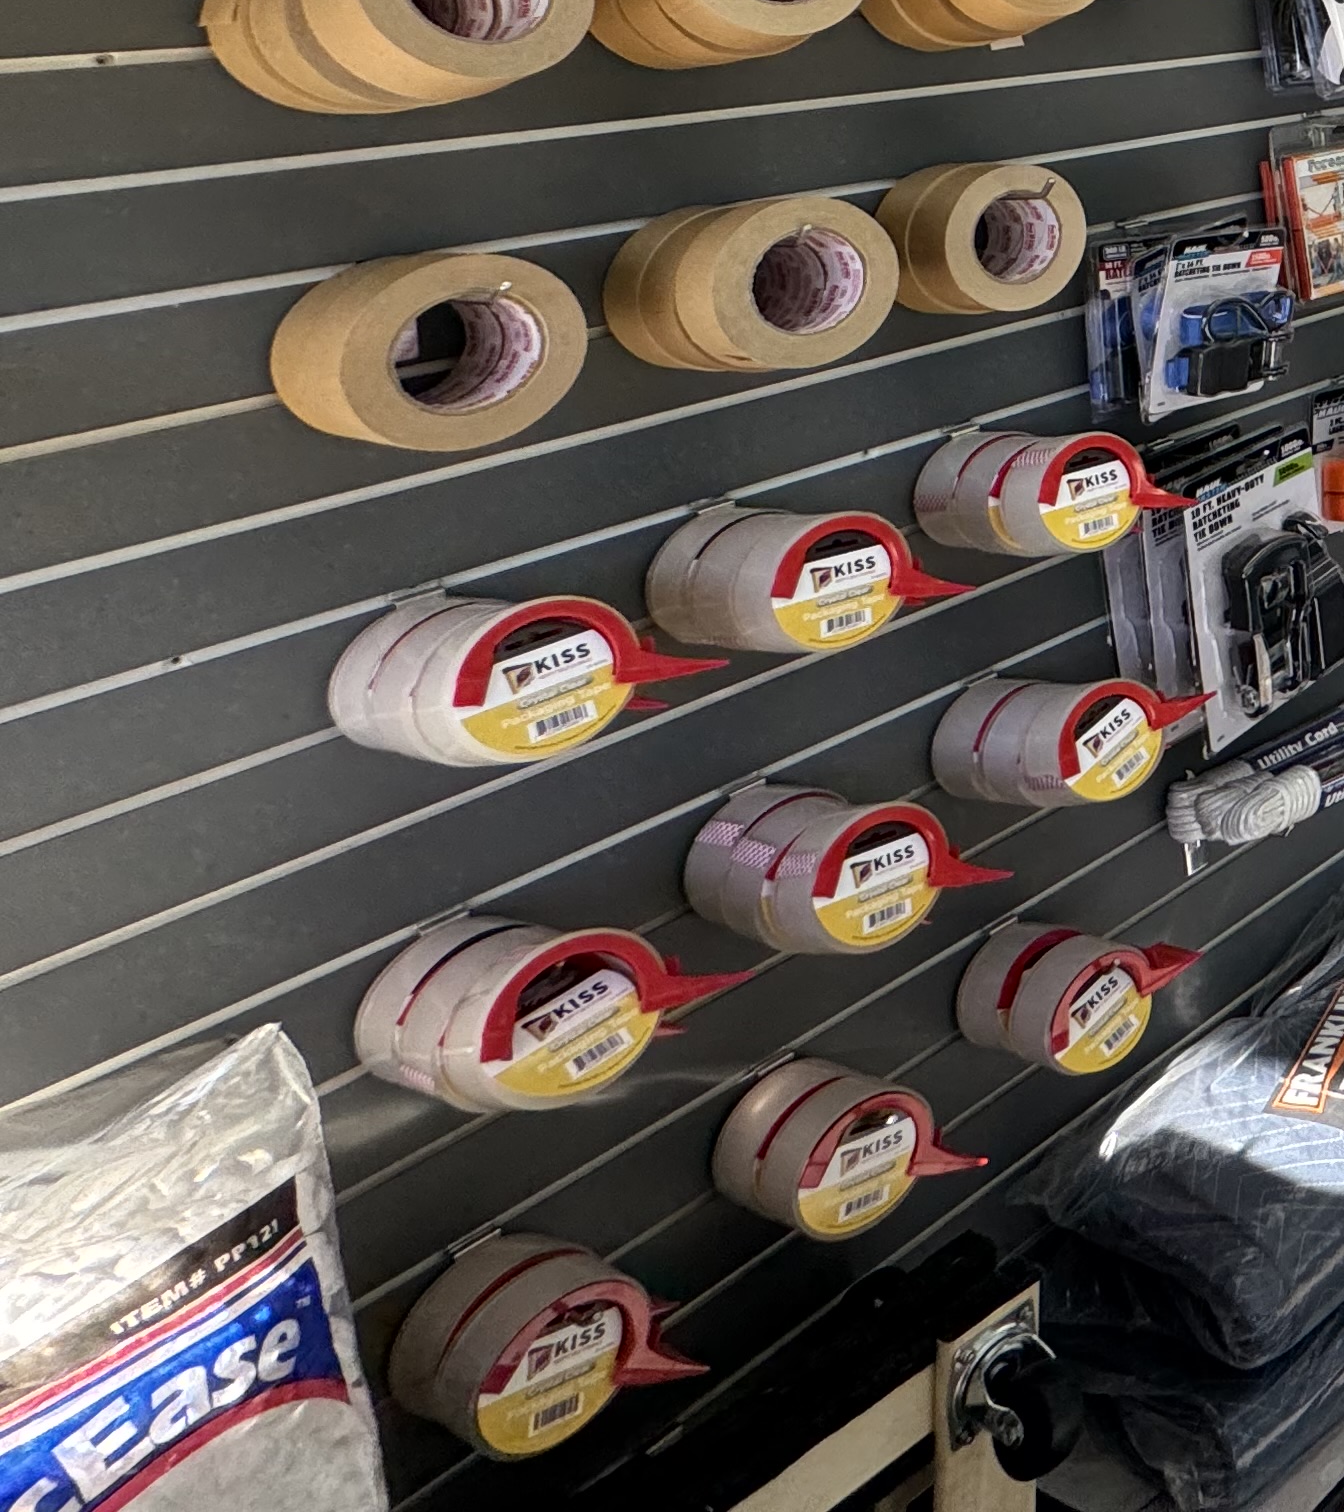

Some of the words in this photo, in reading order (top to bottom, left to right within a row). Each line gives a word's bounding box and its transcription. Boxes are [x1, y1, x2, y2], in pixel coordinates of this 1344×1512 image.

[1085, 469, 1118, 488] KISS
[1203, 500, 1214, 514] FT.
[1217, 474, 1264, 506] HEAVY-DUTY
[1193, 499, 1240, 531] RATCHETING
[1194, 528, 1206, 542] TIE
[1208, 514, 1233, 534] DOWN
[834, 556, 876, 578] KISS
[534, 642, 591, 674] KISS
[1100, 709, 1131, 739] KISS
[1257, 740, 1303, 769] Utility
[1305, 722, 1338, 747] Cord
[874, 845, 915, 871] KISS
[553, 981, 608, 1019] KISS
[1087, 976, 1119, 1009] KISS
[862, 1129, 903, 1159] KISS
[109, 1268, 207, 1335] ITEM#
[554, 1322, 606, 1358] KISS
[8, 1317, 301, 1512] Ease
